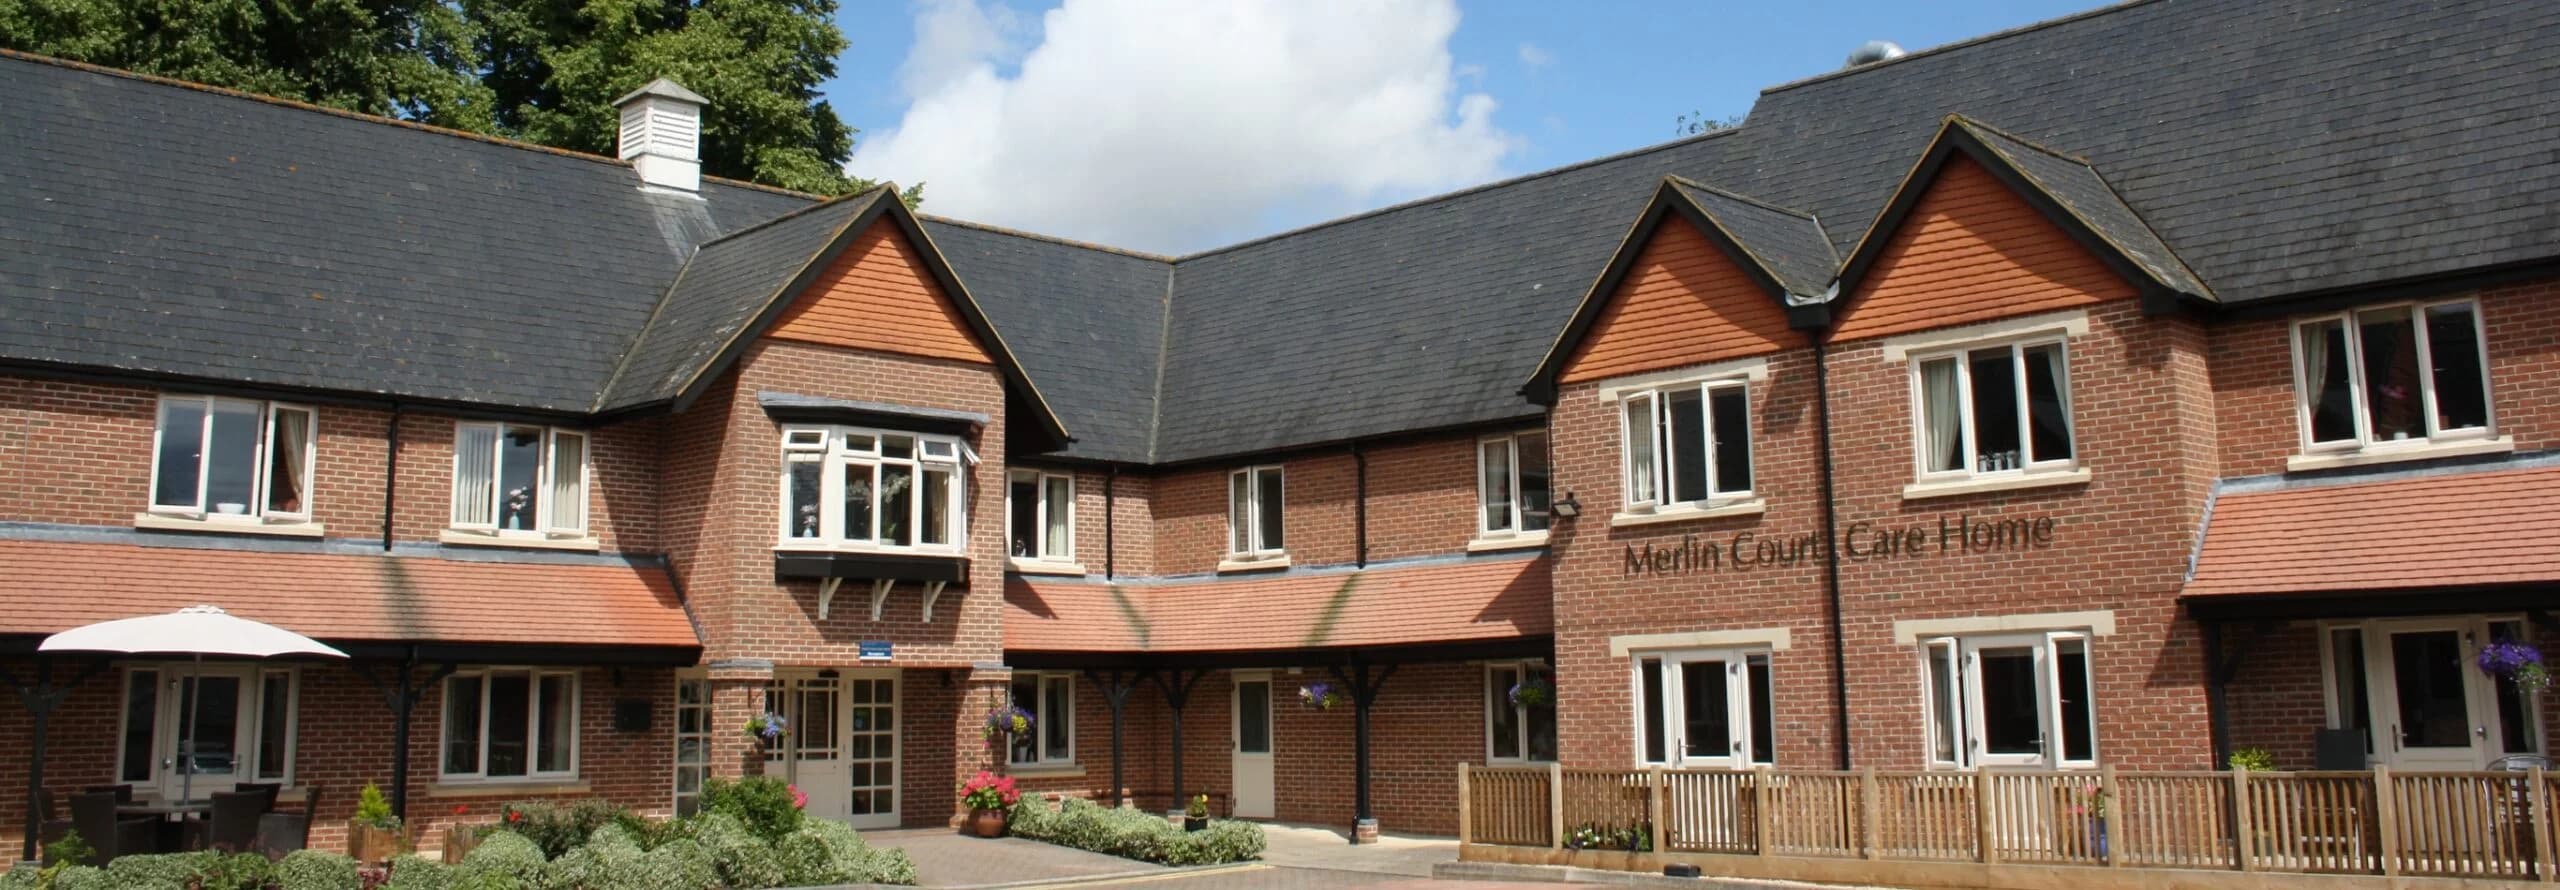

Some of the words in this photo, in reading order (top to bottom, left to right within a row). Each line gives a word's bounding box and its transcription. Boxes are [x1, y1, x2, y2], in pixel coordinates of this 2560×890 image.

[1624, 536, 1720, 577] Merlin
[1732, 530, 1824, 567] Court
[1845, 522, 1925, 558] Care
[1940, 515, 2053, 554] Home
